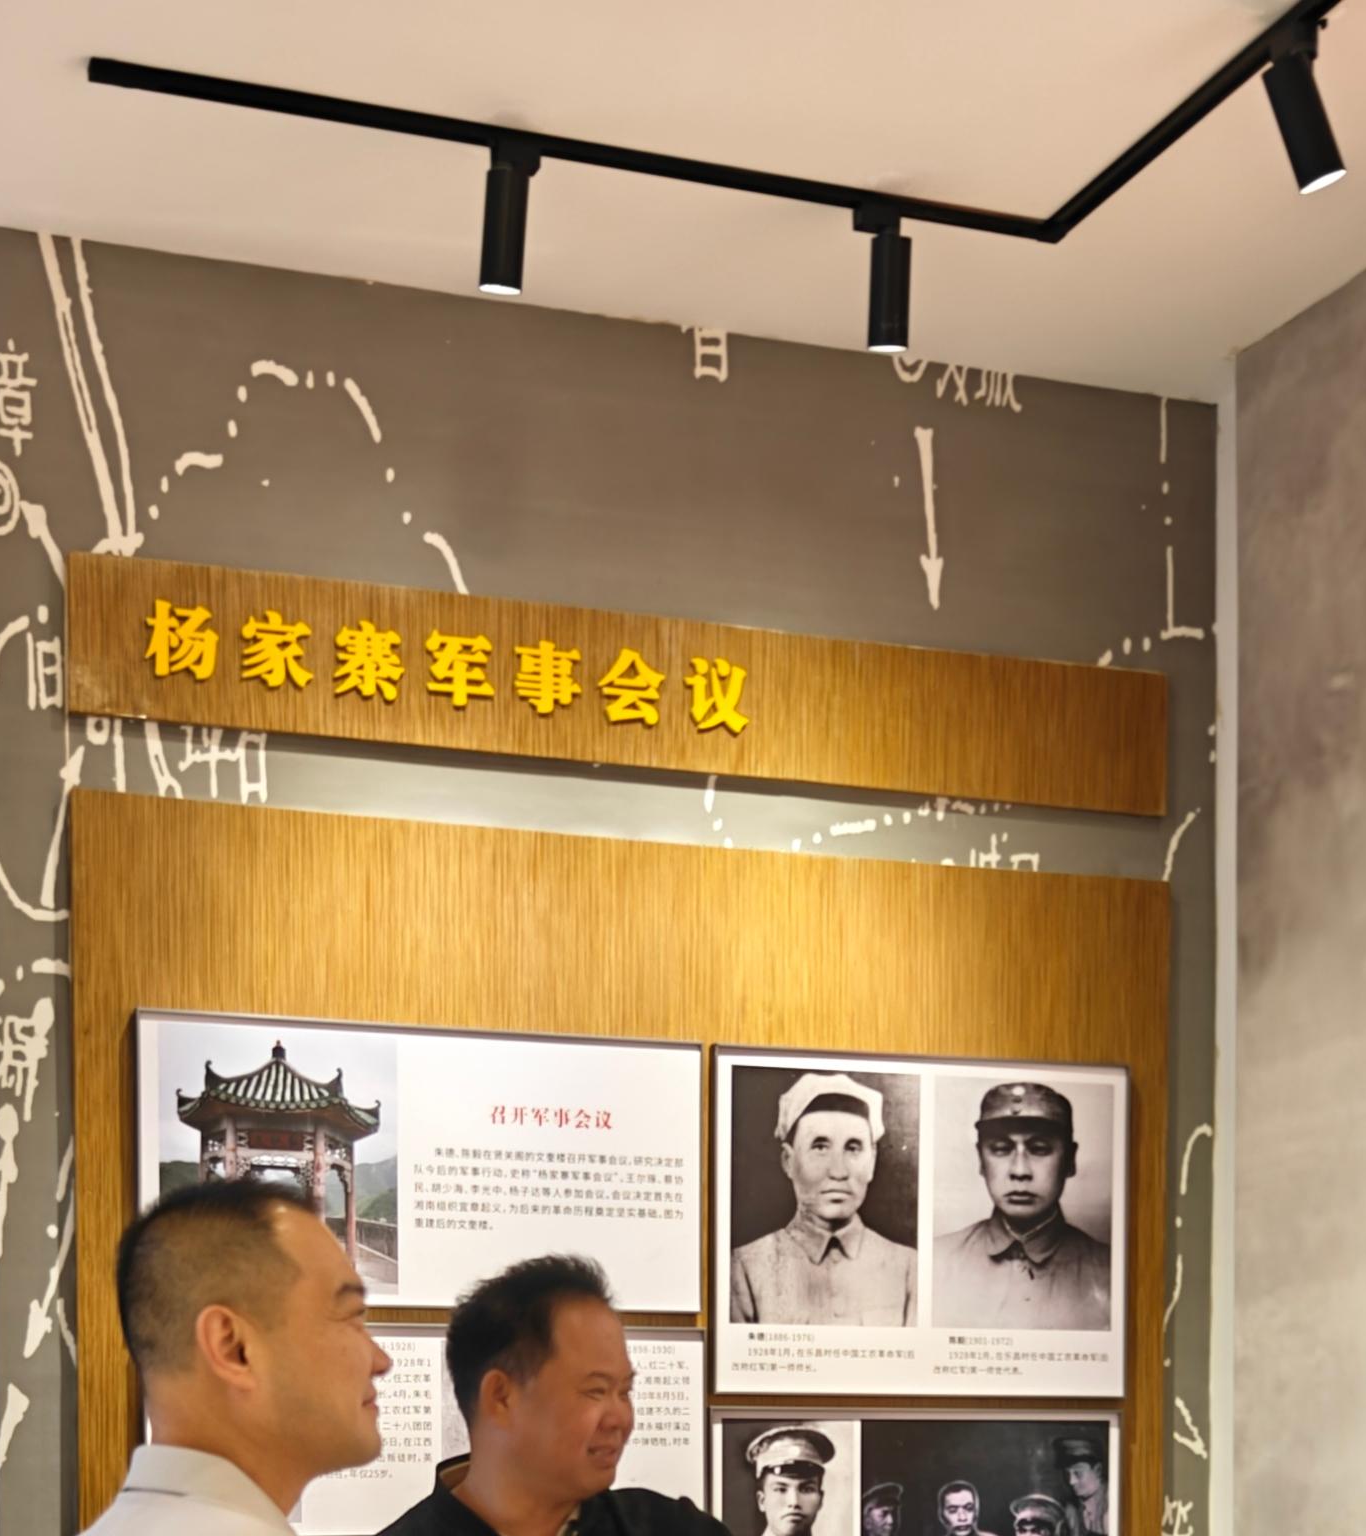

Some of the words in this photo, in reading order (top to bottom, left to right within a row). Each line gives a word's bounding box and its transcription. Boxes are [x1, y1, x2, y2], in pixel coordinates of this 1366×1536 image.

[144, 598, 752, 737] 杨家寨军事会议
[490, 1105, 613, 1130] 召开军事会议
